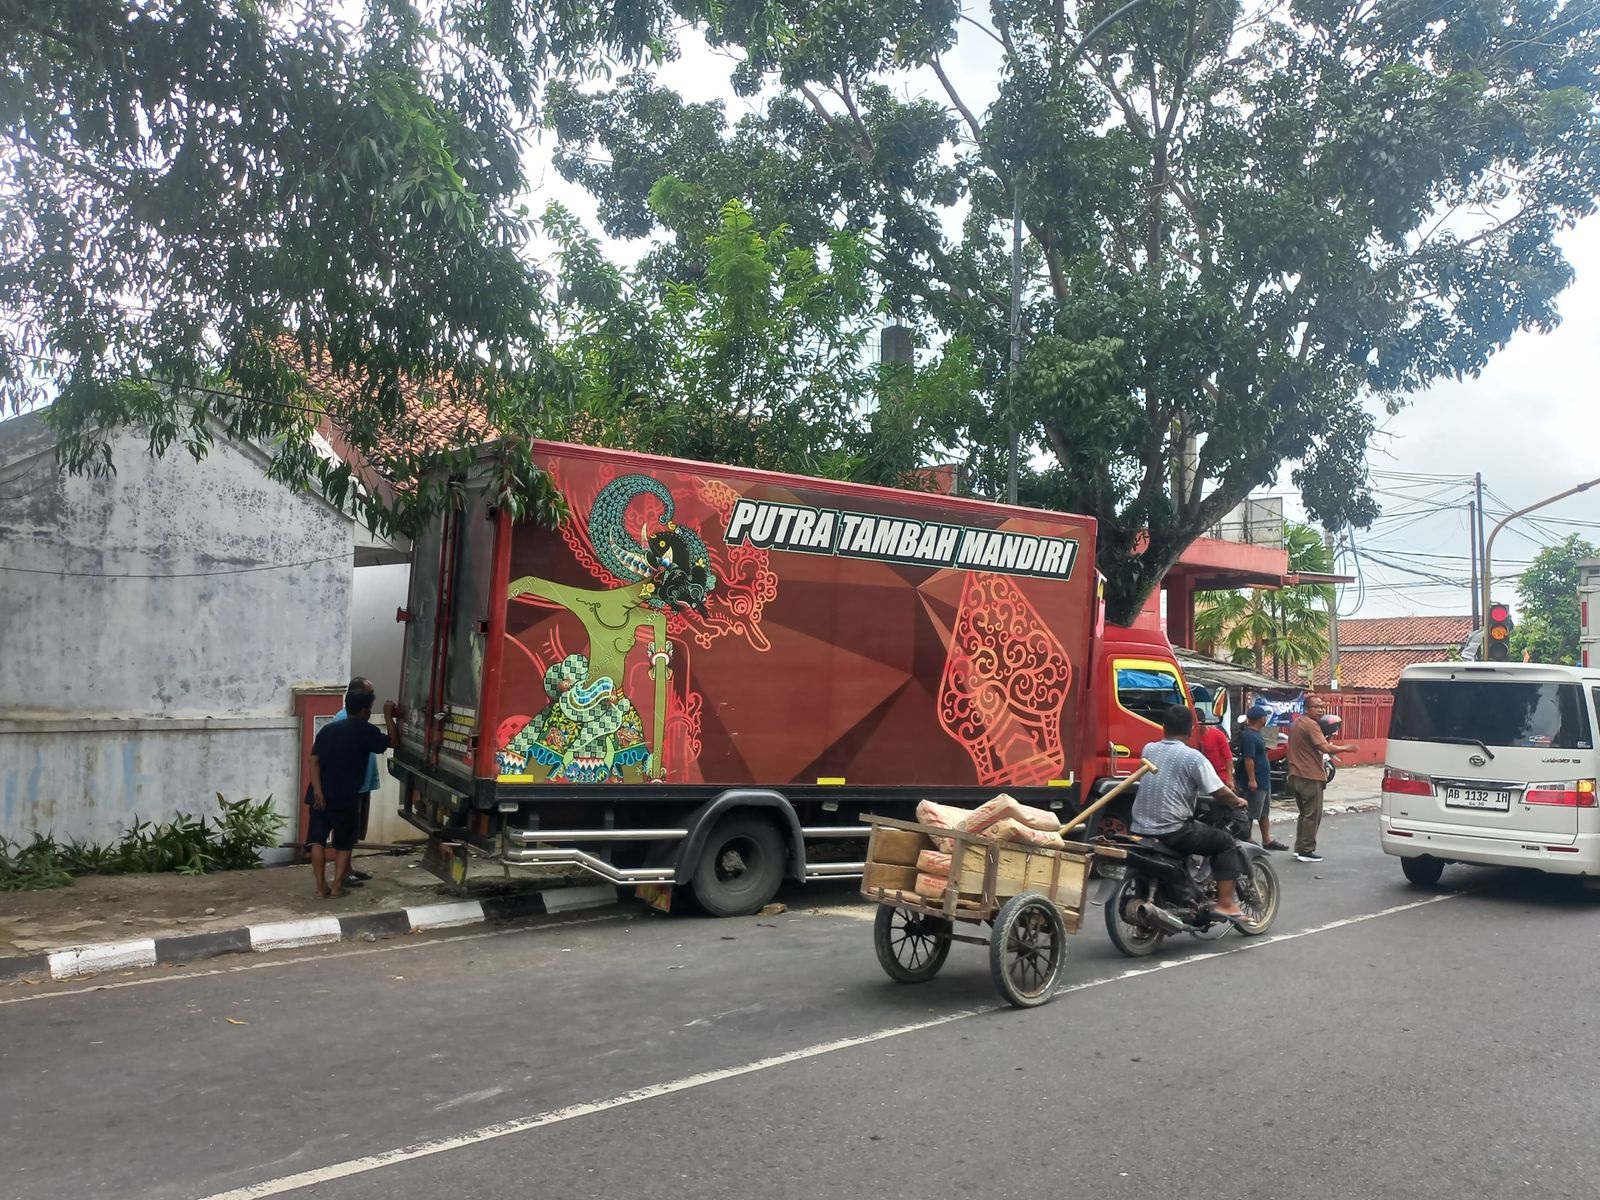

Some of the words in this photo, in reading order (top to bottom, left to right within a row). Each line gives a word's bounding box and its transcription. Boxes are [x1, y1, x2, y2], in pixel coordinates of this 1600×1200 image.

[728, 501, 837, 549] PUTRA
[838, 514, 961, 563] TAMBAH
[956, 530, 1077, 575] MANDIRI
[1448, 788, 1460, 800] AB
[1464, 790, 1489, 802] 1132
[1495, 792, 1508, 803] IH
